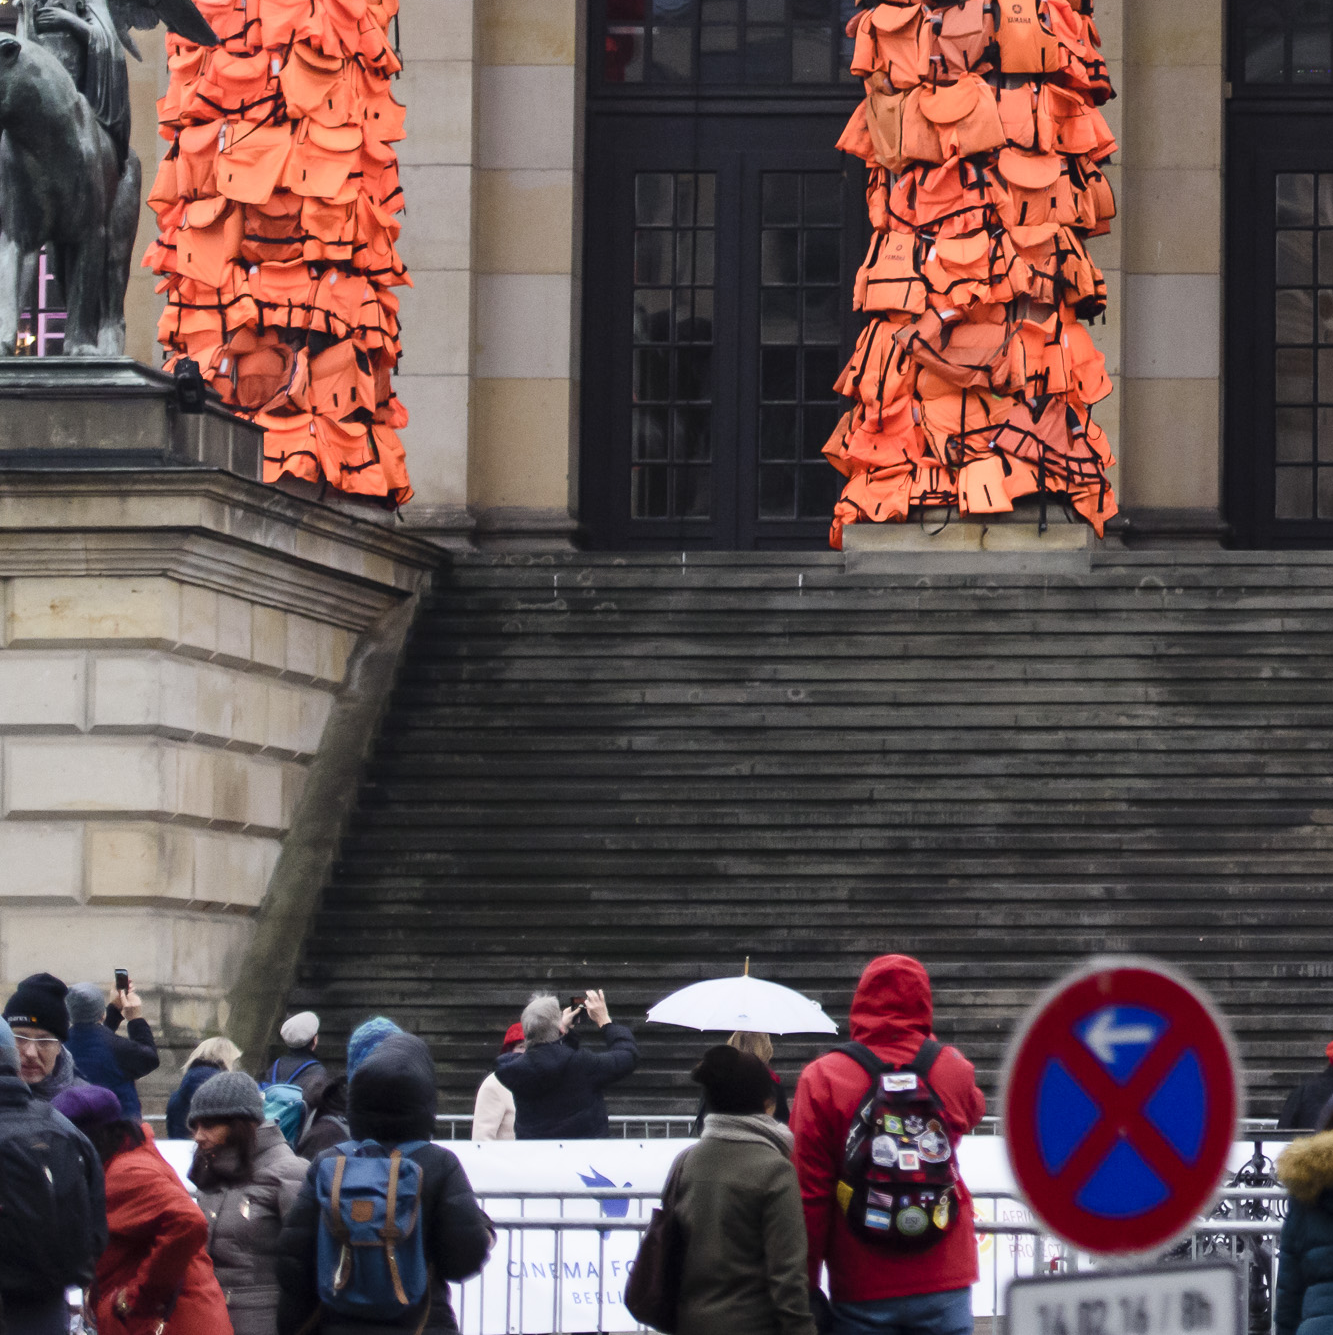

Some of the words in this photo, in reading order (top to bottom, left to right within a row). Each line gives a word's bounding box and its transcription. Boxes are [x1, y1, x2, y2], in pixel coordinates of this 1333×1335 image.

[1007, 16, 1032, 24] YAMAHA
[507, 1260, 599, 1280] CINEMA
[572, 1291, 623, 1305] BERLI
